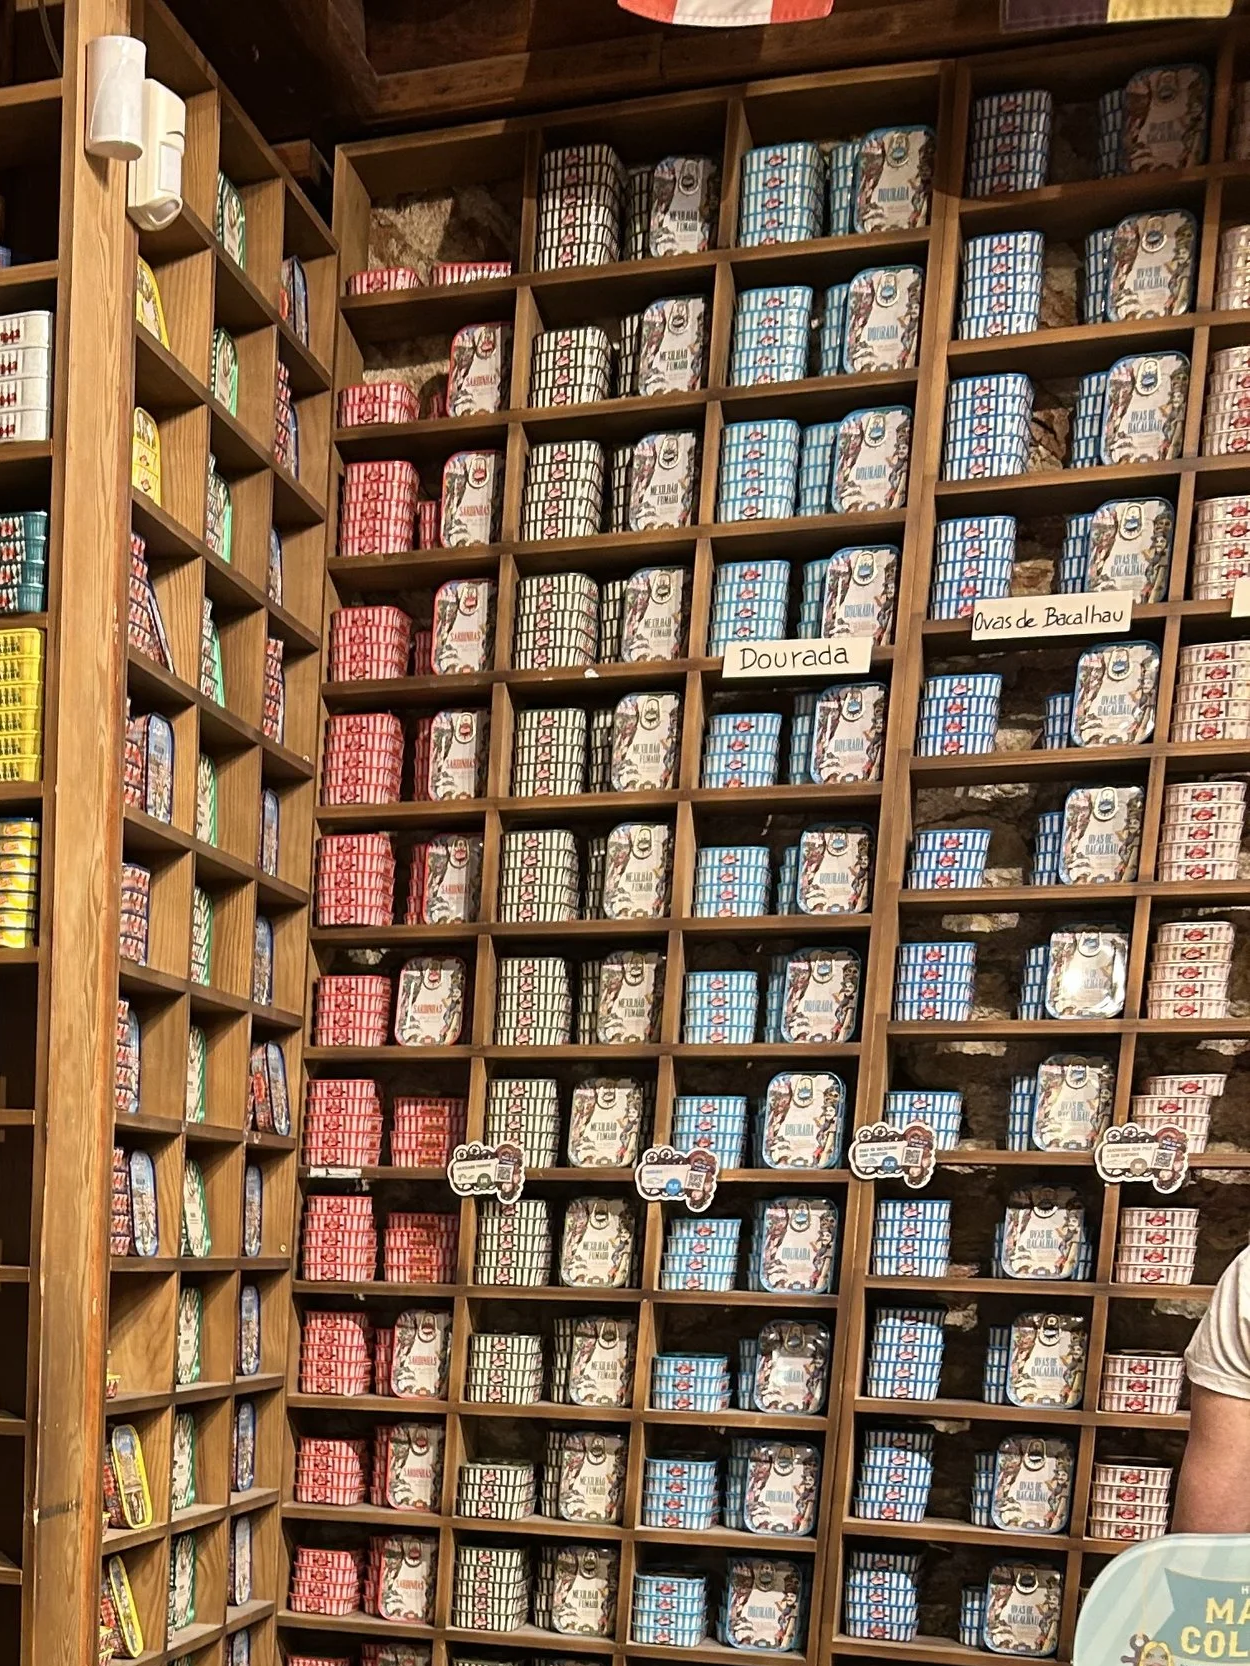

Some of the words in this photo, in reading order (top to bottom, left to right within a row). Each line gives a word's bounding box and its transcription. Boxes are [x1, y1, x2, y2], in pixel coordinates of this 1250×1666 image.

[0, 329, 20, 343] 1942
[974, 614, 1012, 632] Ovas
[1017, 613, 1037, 629] de
[1043, 606, 1125, 629] Bacalhau
[739, 645, 850, 671] Dourada
[1181, 1626, 1248, 1658] COL
